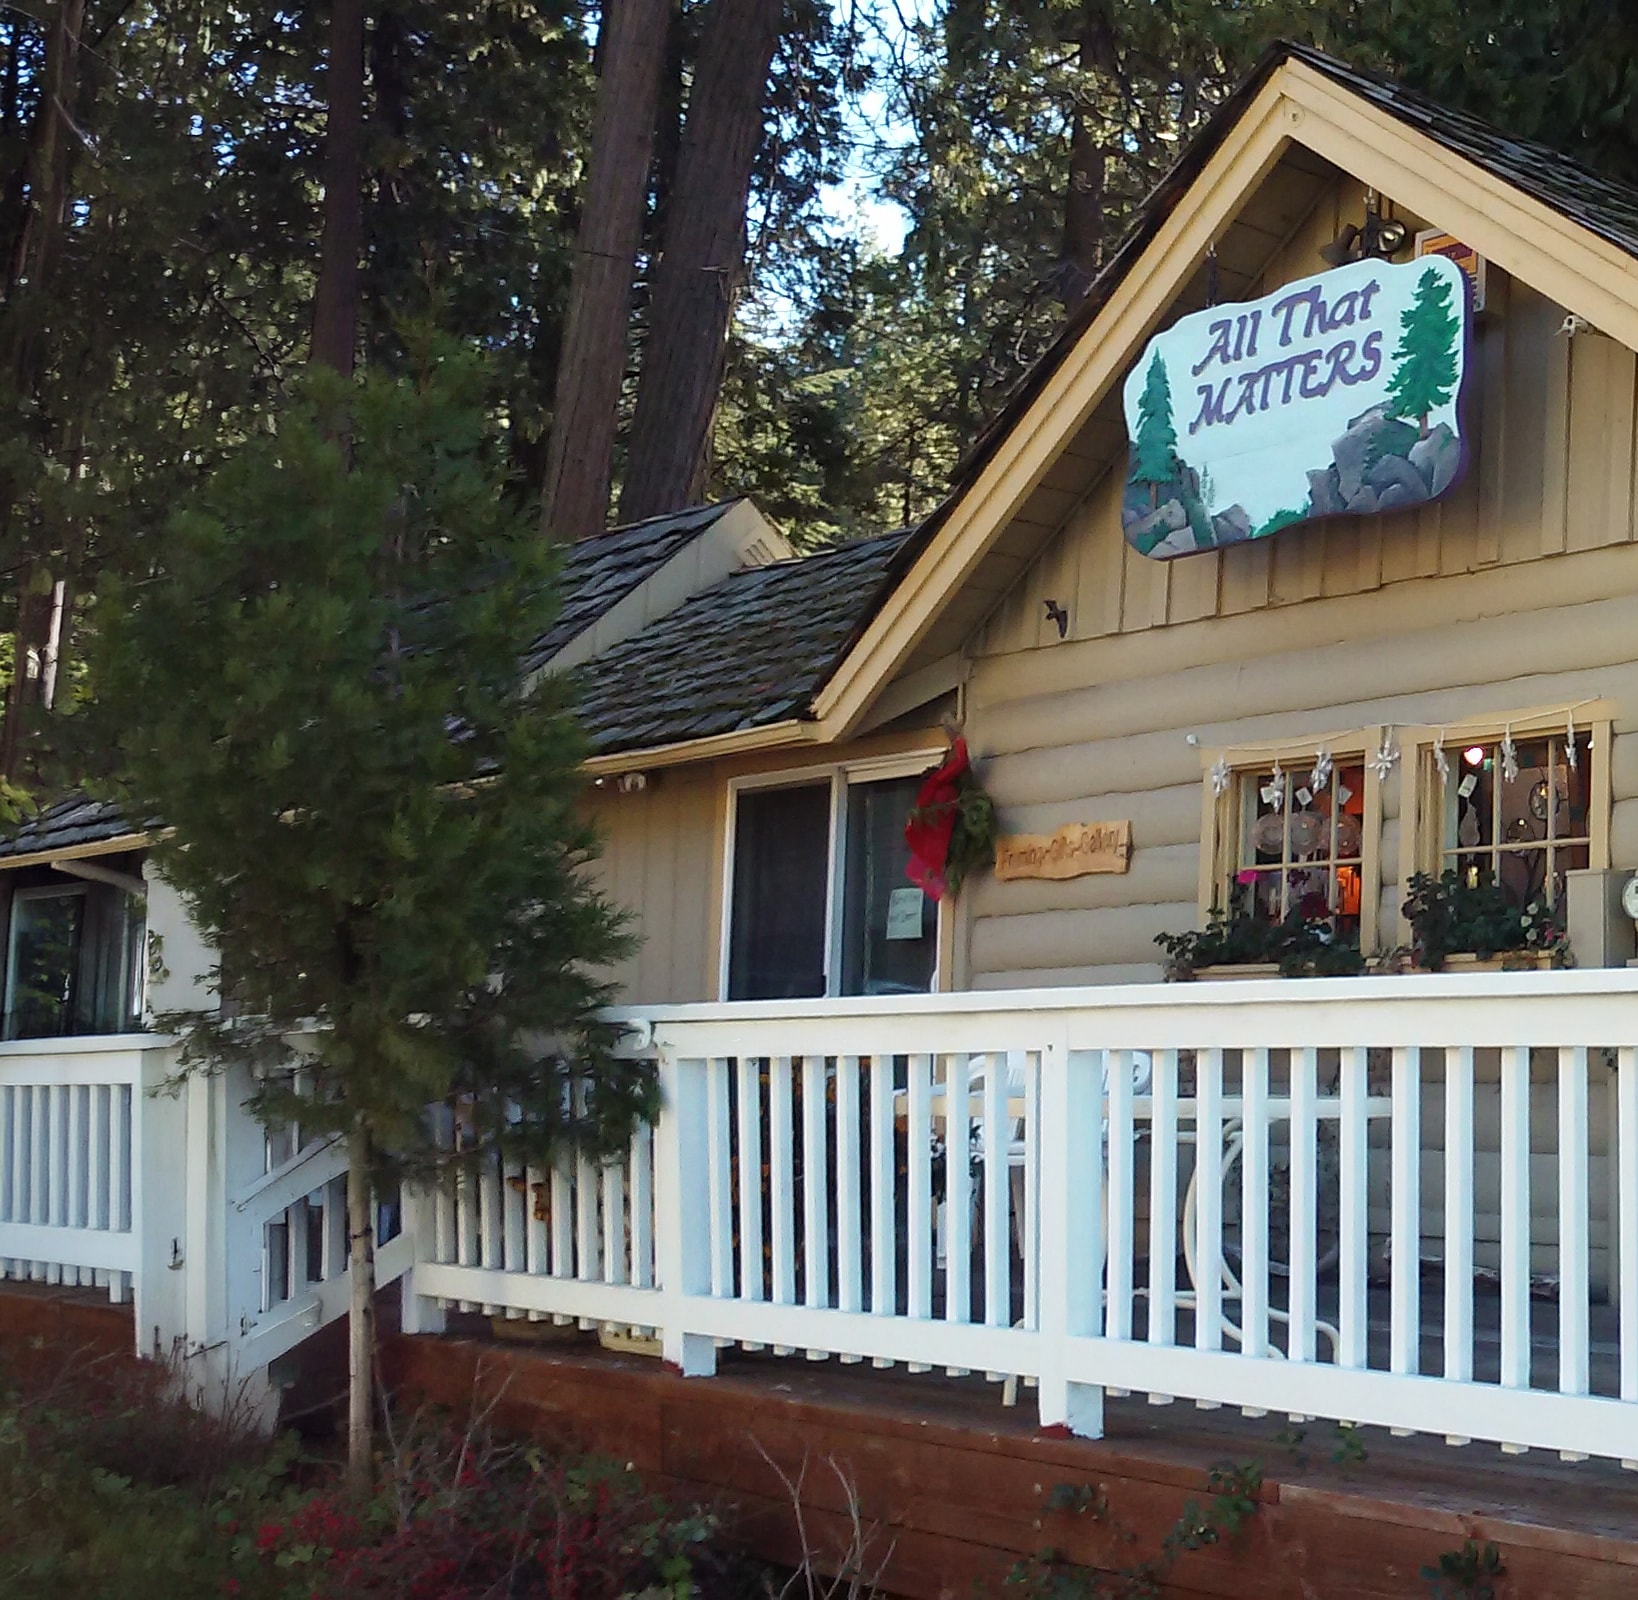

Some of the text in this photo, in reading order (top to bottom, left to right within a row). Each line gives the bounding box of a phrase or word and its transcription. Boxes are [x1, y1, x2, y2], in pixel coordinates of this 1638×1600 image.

[1191, 279, 1381, 377] All That
[1188, 330, 1383, 435] MATTERS
